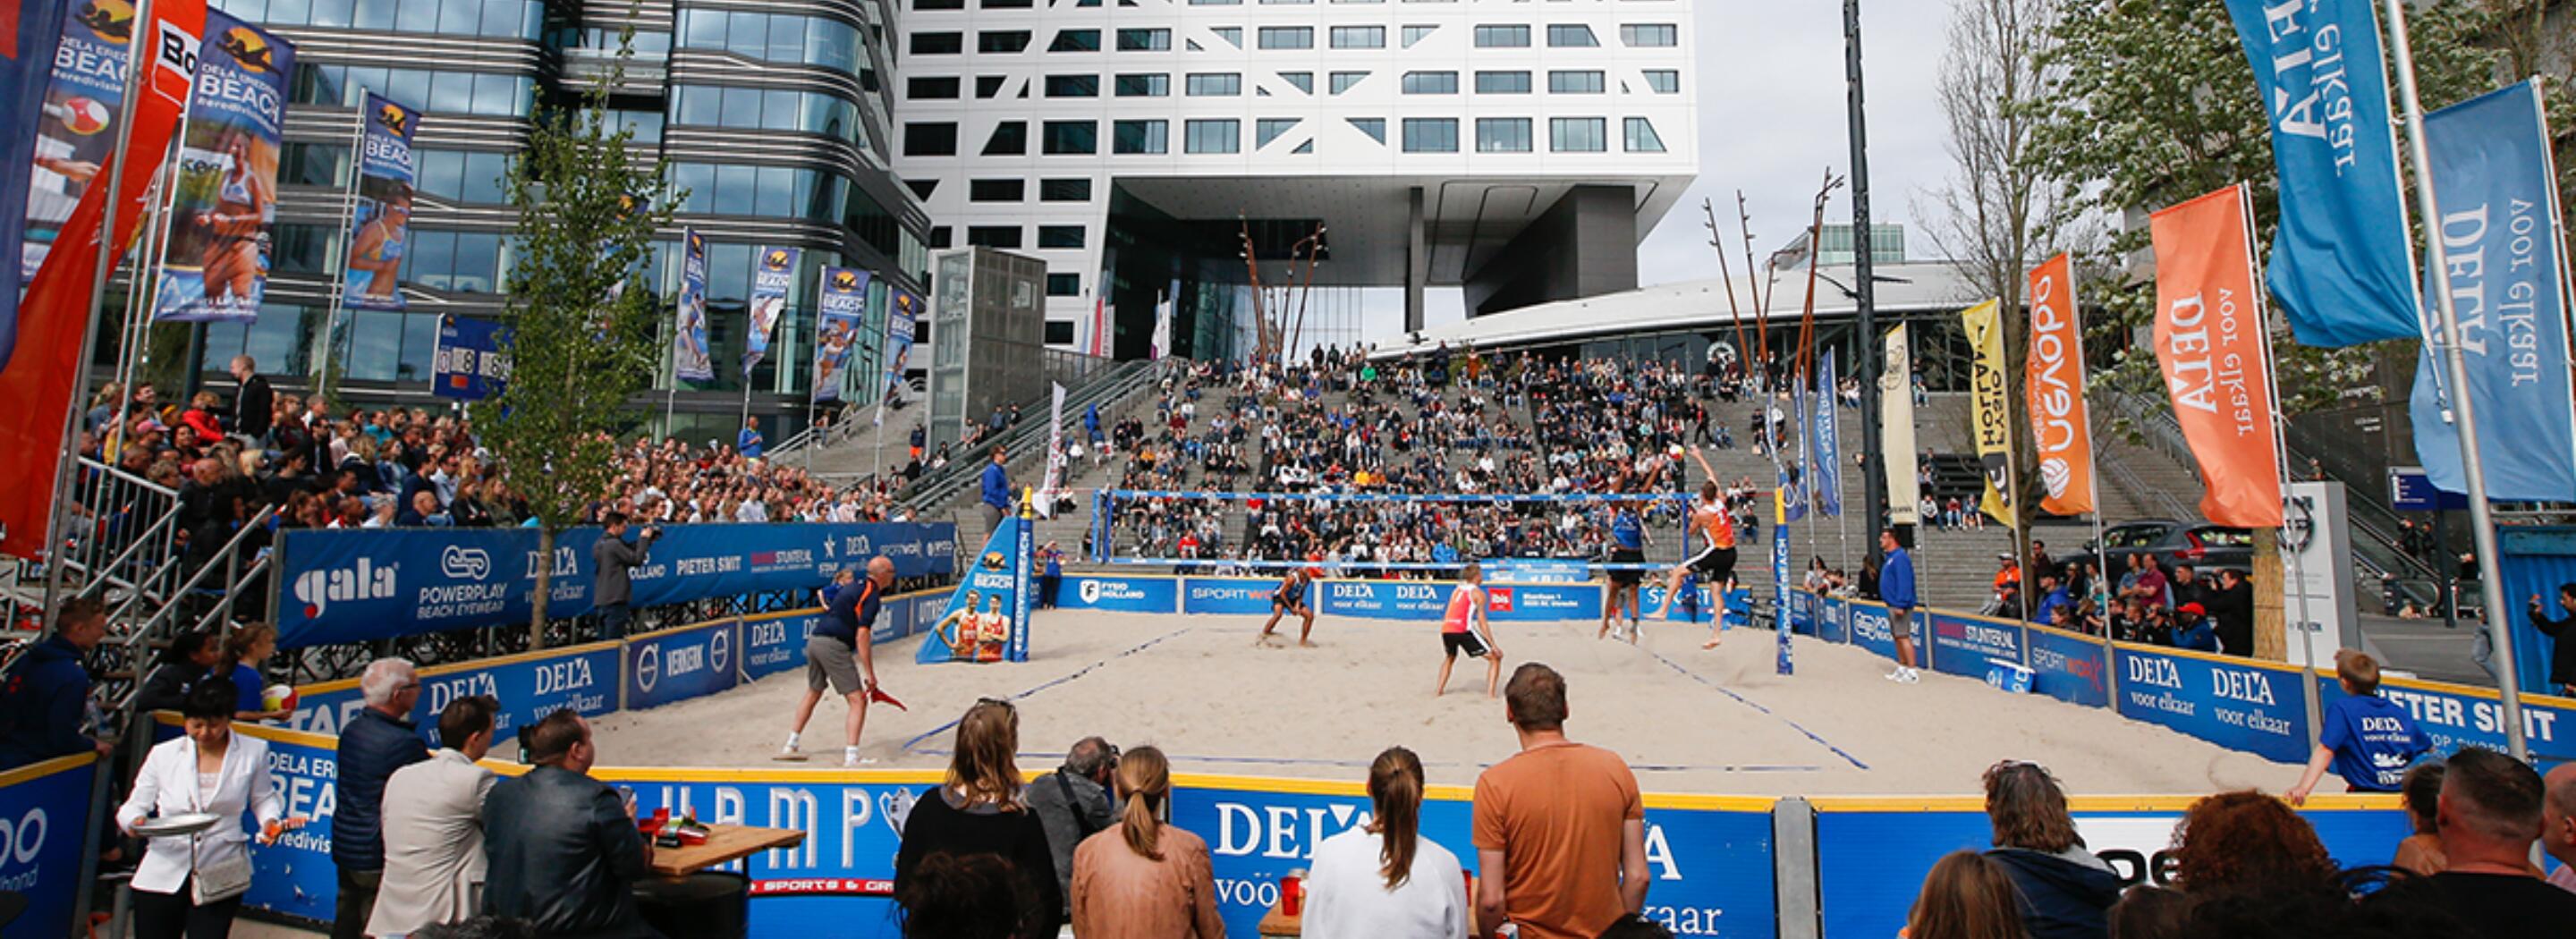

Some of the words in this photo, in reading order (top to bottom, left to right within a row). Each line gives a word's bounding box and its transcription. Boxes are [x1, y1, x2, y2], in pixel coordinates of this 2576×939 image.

[55, 47, 129, 81] BEAC
[525, 546, 579, 579] DLA
[629, 563, 666, 579] OLLAND
[294, 556, 396, 619] gala
[419, 582, 508, 605] POWERPLAY
[1191, 588, 1275, 600] SPORTWO
[1333, 583, 1374, 598] DELA
[1396, 584, 1438, 599] DELA
[417, 605, 453, 620] BEACH
[456, 600, 505, 617] EYEWEAR
[751, 620, 786, 647] DELA
[665, 642, 704, 678] VERKERK
[535, 657, 593, 696] DELA
[2128, 656, 2182, 689] DELA
[2211, 668, 2276, 706] DELA
[2131, 691, 2157, 708] voor
[2158, 692, 2196, 715] elkaar
[2215, 707, 2245, 726] voor
[2248, 708, 2292, 736] elkaar
[2361, 716, 2404, 732] DELA
[267, 751, 308, 775] DELA
[270, 774, 338, 823] BEA
[1214, 802, 1373, 859] DEL
[763, 879, 839, 892] SPORTS
[844, 881, 859, 891] &
